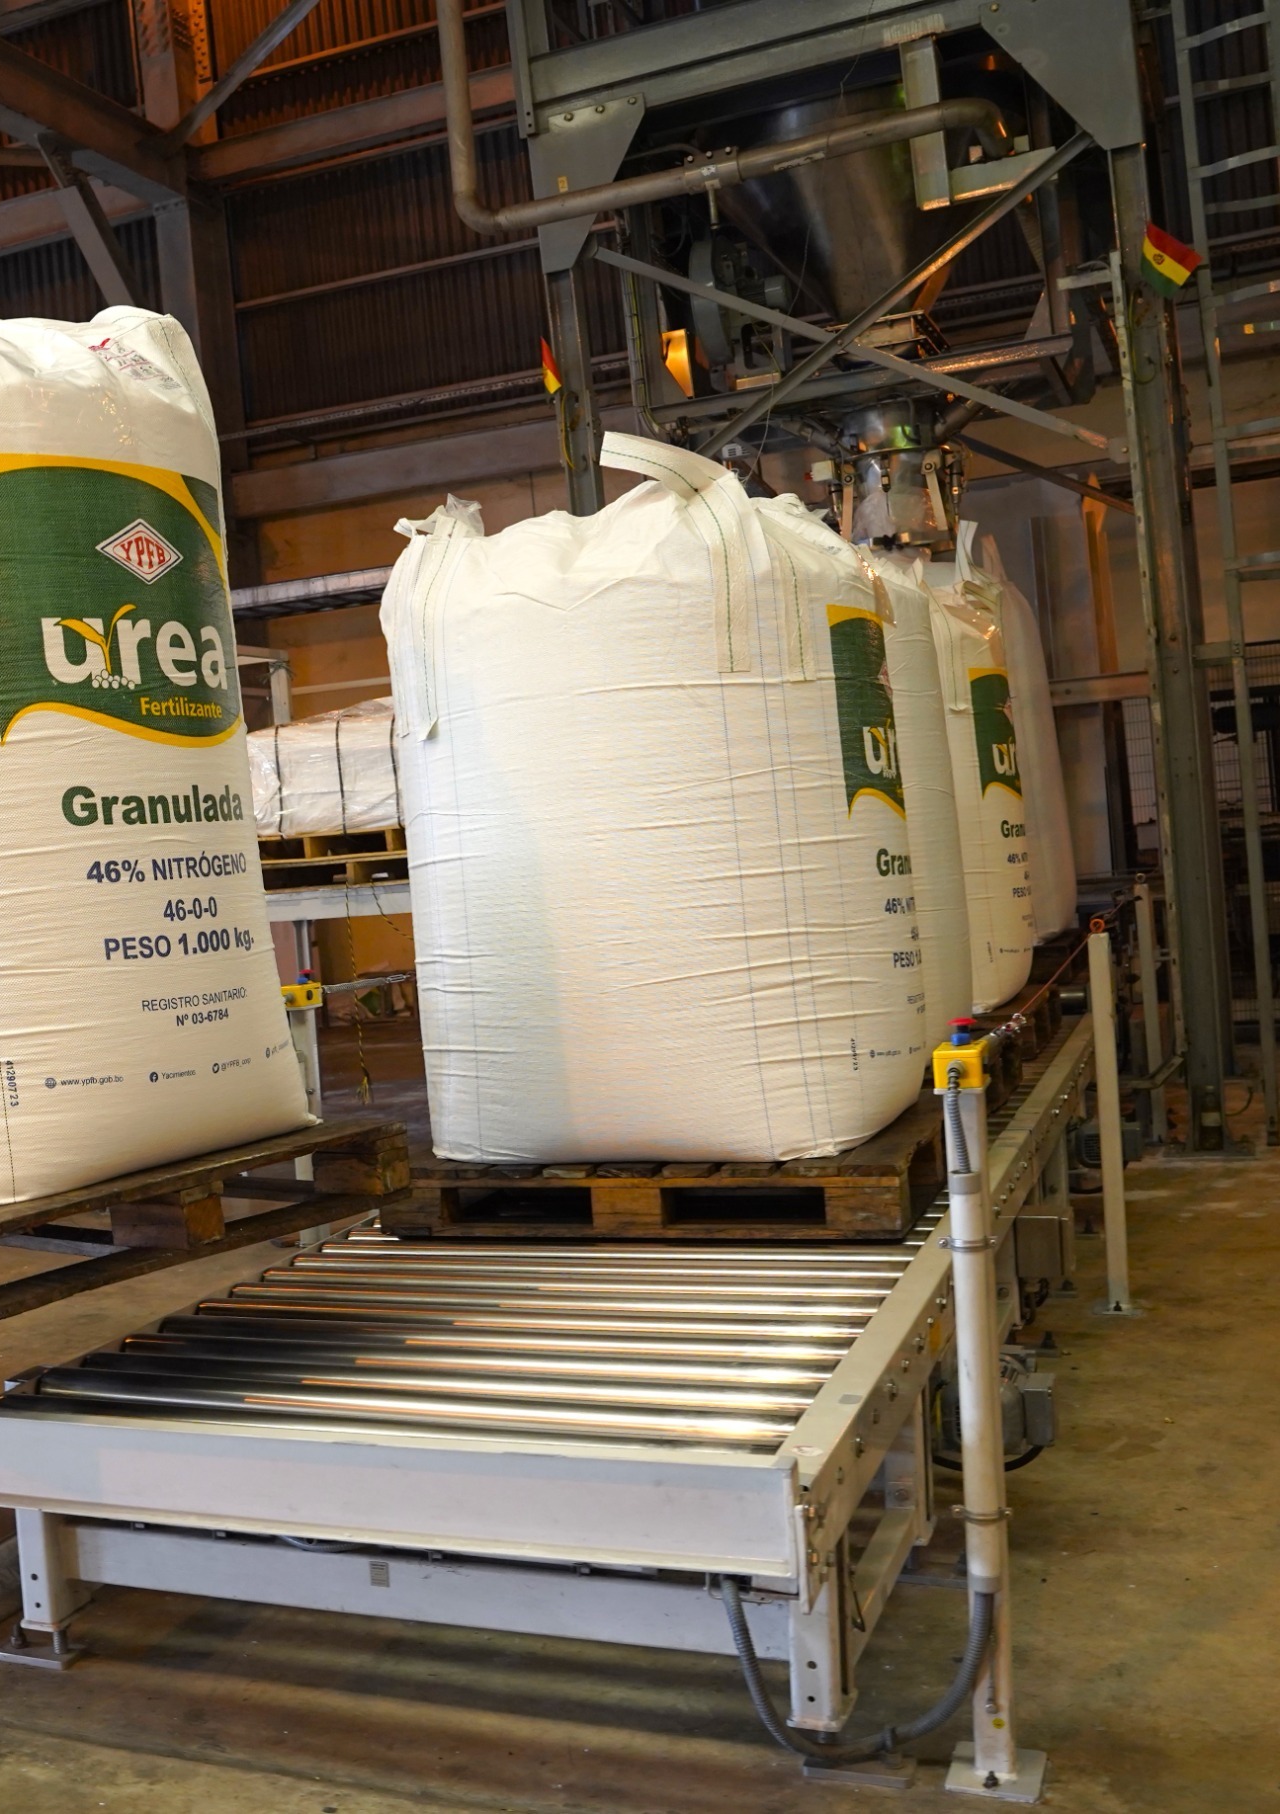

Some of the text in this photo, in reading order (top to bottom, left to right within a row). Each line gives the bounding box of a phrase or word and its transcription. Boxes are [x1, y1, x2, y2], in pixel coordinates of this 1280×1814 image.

[120, 536, 166, 570] YPFB
[40, 615, 228, 691] urea
[140, 697, 223, 719] Fertilizante
[61, 784, 244, 827] Granulada
[86, 851, 247, 884] 46% NITRÓGENO
[163, 896, 218, 922] 46-0-0
[104, 926, 256, 960] PESO 1.000 kg.
[142, 993, 200, 1012] REGISTRO
[191, 1008, 230, 1026] 03-6784
[60, 1074, 125, 1087] www.ypfb.gob.bo
[161, 1069, 197, 1080] Yacimientos
